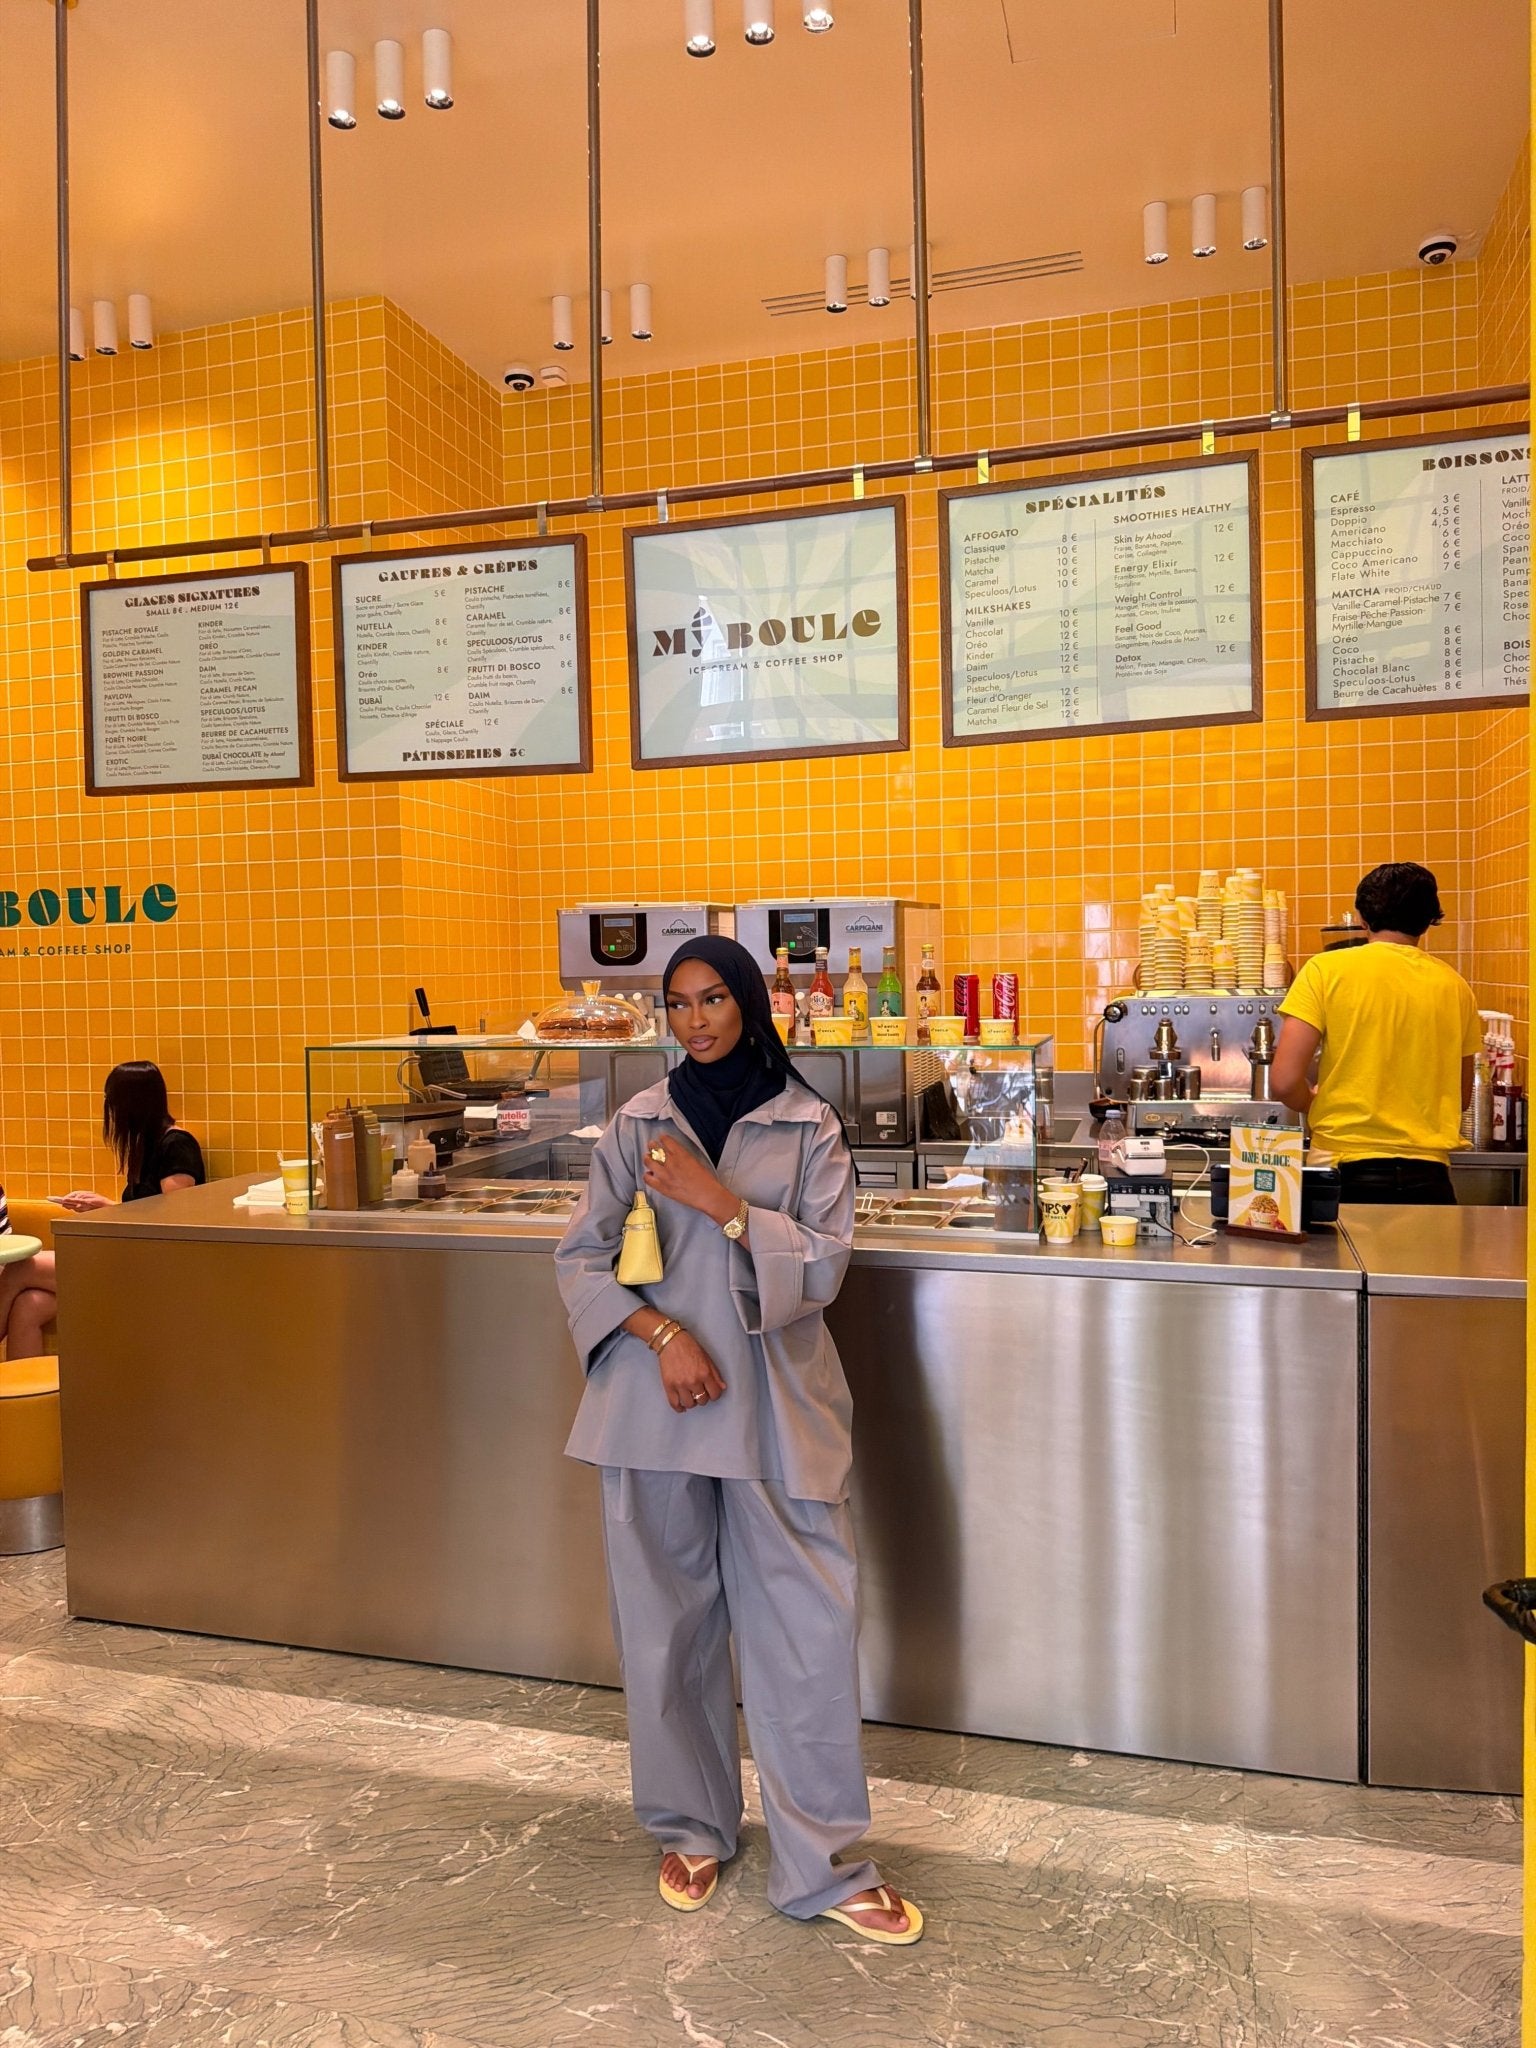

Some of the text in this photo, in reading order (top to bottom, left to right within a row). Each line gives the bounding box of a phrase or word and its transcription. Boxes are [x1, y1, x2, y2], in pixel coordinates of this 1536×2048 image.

[1025, 485, 1166, 514] SPÉCIALITÉS
[1330, 490, 1360, 503] CAFÉ
[1113, 503, 1231, 524] SMOOTHIES HEALTHY
[1331, 504, 1376, 517] Espresso
[1432, 506, 1449, 517] 4,5
[1331, 516, 1367, 527] Doppio
[1502, 521, 1530, 531] Oréo
[1214, 524, 1224, 533] 12
[1331, 526, 1386, 537] Americano
[964, 528, 1019, 543] AFFOGATO
[1114, 530, 1172, 544] Skin by Ahood
[1502, 533, 1530, 542] Coco
[1331, 537, 1383, 548] Macchiato
[964, 544, 1006, 555] Classique
[1331, 547, 1393, 561] Cappuccino
[965, 555, 1000, 565] Pistache
[1331, 555, 1418, 570] Coco Americano
[378, 559, 538, 583] GAUFRES & CRÊPES
[965, 566, 994, 577] Matcha
[1115, 560, 1178, 574] Energy Elixir
[1331, 569, 1390, 581] Flate White
[965, 576, 999, 588] Caramel
[464, 585, 505, 595] PISTACHE
[965, 584, 1037, 599] Speculoos/Lotus
[1331, 583, 1442, 599] MATCHA FROID/CHAUD
[125, 586, 261, 608] GLACES SIGNATURES
[356, 594, 382, 604] SUCRE
[1115, 588, 1182, 604] Weight Control
[146, 608, 170, 617] SMALL
[190, 604, 222, 613] MEDIUM
[965, 601, 1031, 615] MILKSHAKES
[1503, 602, 1529, 610] Rose
[466, 612, 506, 621] CARAMEL
[198, 620, 223, 628] KINDER
[356, 622, 392, 631] NUTELLA
[966, 619, 994, 627] Vanille
[1115, 621, 1162, 633] Feel Good
[102, 625, 159, 636] PISTACHE ROYALE
[966, 628, 1003, 639] Chocolat
[467, 635, 543, 648] SPECULOOS/LOTUS
[1333, 635, 1358, 644] Oréo
[357, 642, 388, 650] KINDER
[966, 641, 988, 650] Oréo
[1333, 646, 1359, 655] Coco
[102, 650, 129, 658] GOLDEN
[966, 651, 994, 660] Kinder
[1115, 654, 1141, 663] Detox
[753, 661, 760, 669] &
[765, 657, 807, 668] COFFEE
[812, 653, 843, 664] SHOP
[1333, 655, 1375, 666] Pistache
[199, 665, 217, 673] DAIM
[467, 662, 541, 674] FRUTTI DI BOSCO
[967, 664, 988, 672] Daim
[1333, 663, 1410, 677] Chocolat Blanc
[103, 669, 164, 679] BROWNIE PASSION
[967, 670, 1038, 684] Speculoos/Lotus
[1333, 674, 1416, 688] Speculoos-Lotus
[1504, 677, 1527, 686] Thés
[200, 684, 257, 694] CARAMEL PECAN
[1334, 688, 1364, 699] Beurre
[1367, 687, 1379, 696] de
[359, 695, 383, 705] DUBAÏ
[468, 692, 490, 700] DAIM
[967, 696, 986, 704] Fleur
[967, 700, 1049, 716] Caramel Fleur de Sel
[105, 714, 126, 722] FRUTTI
[1061, 710, 1070, 718] 12
[425, 719, 464, 729] SPÉCIALE
[967, 717, 997, 727] Matcha
[126, 734, 147, 742] NOIRE
[201, 729, 227, 738] BEURRE
[223, 750, 262, 759] CHOCOLATE
[845, 924, 883, 932] CARPIGIANI
[23, 946, 30, 956] &
[38, 945, 87, 956] COFFEE
[95, 944, 131, 954] SHOP
